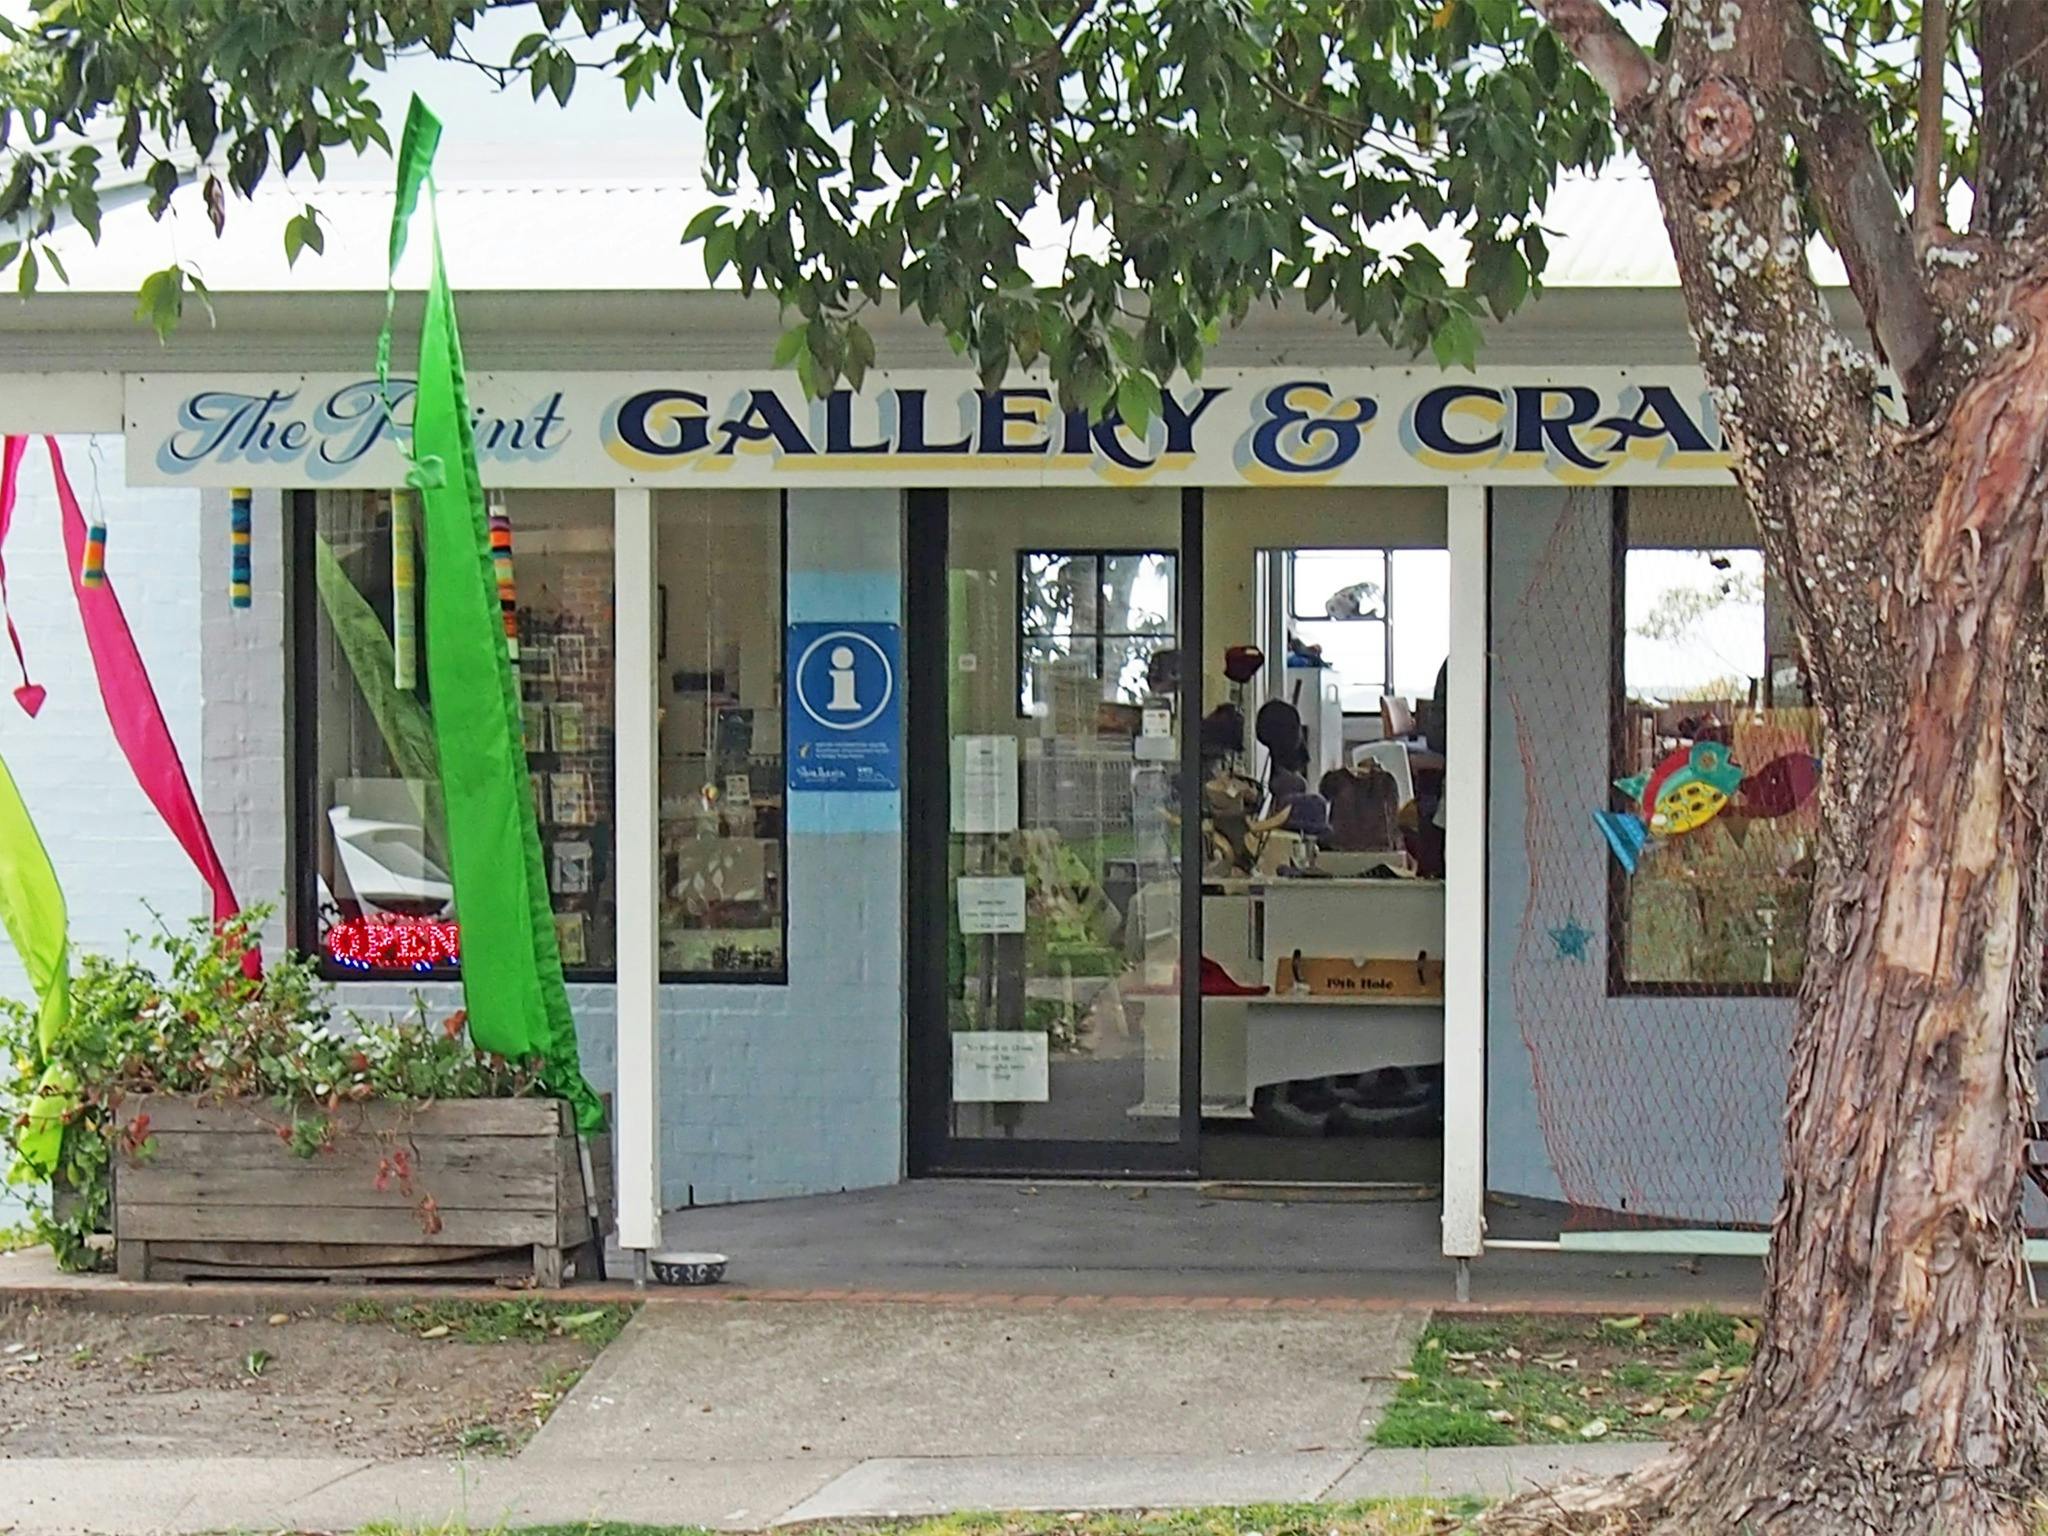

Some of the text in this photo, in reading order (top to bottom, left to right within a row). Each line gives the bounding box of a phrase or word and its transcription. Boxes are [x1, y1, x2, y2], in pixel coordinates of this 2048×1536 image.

[170, 389, 311, 462] The
[320, 379, 571, 463] Pint
[1252, 381, 1378, 472] &
[1413, 386, 1893, 469] CRA
[331, 925, 458, 958] OPEN
[1361, 976, 1394, 990] Hole
